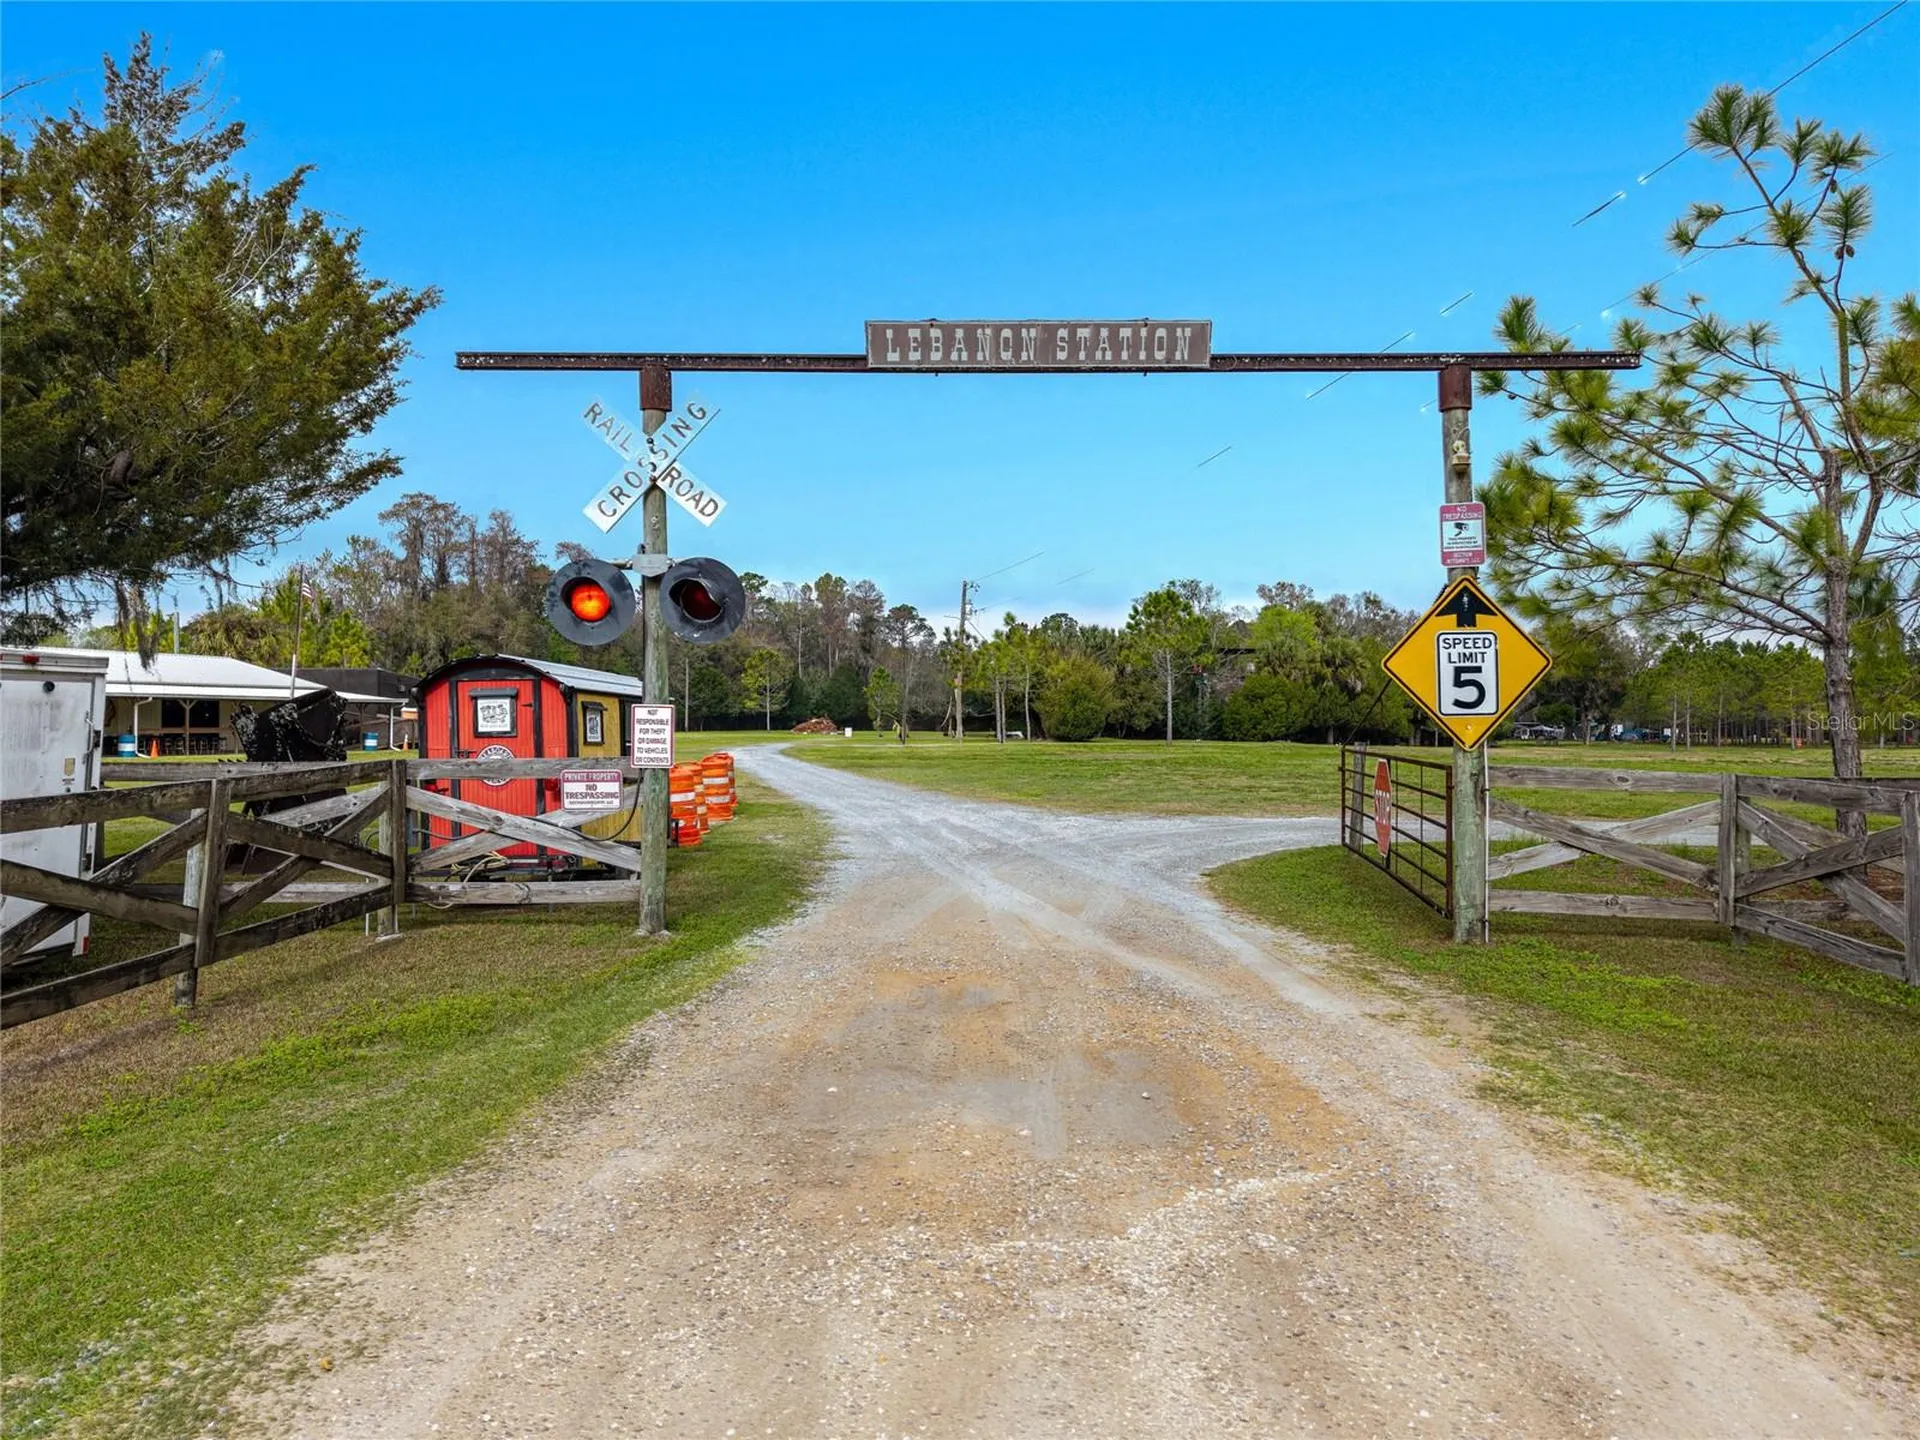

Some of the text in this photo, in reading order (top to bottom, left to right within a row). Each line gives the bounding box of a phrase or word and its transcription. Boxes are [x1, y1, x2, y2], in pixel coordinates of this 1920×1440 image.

[885, 327, 1192, 361] LEBANON STATION
[583, 402, 719, 518] RAIL ROAD
[597, 402, 707, 518] CROSSING
[1442, 637, 1492, 650] SPEED
[1447, 651, 1487, 664] LIMIT
[1452, 665, 1486, 709] 5
[1375, 789, 1390, 825] STOP
